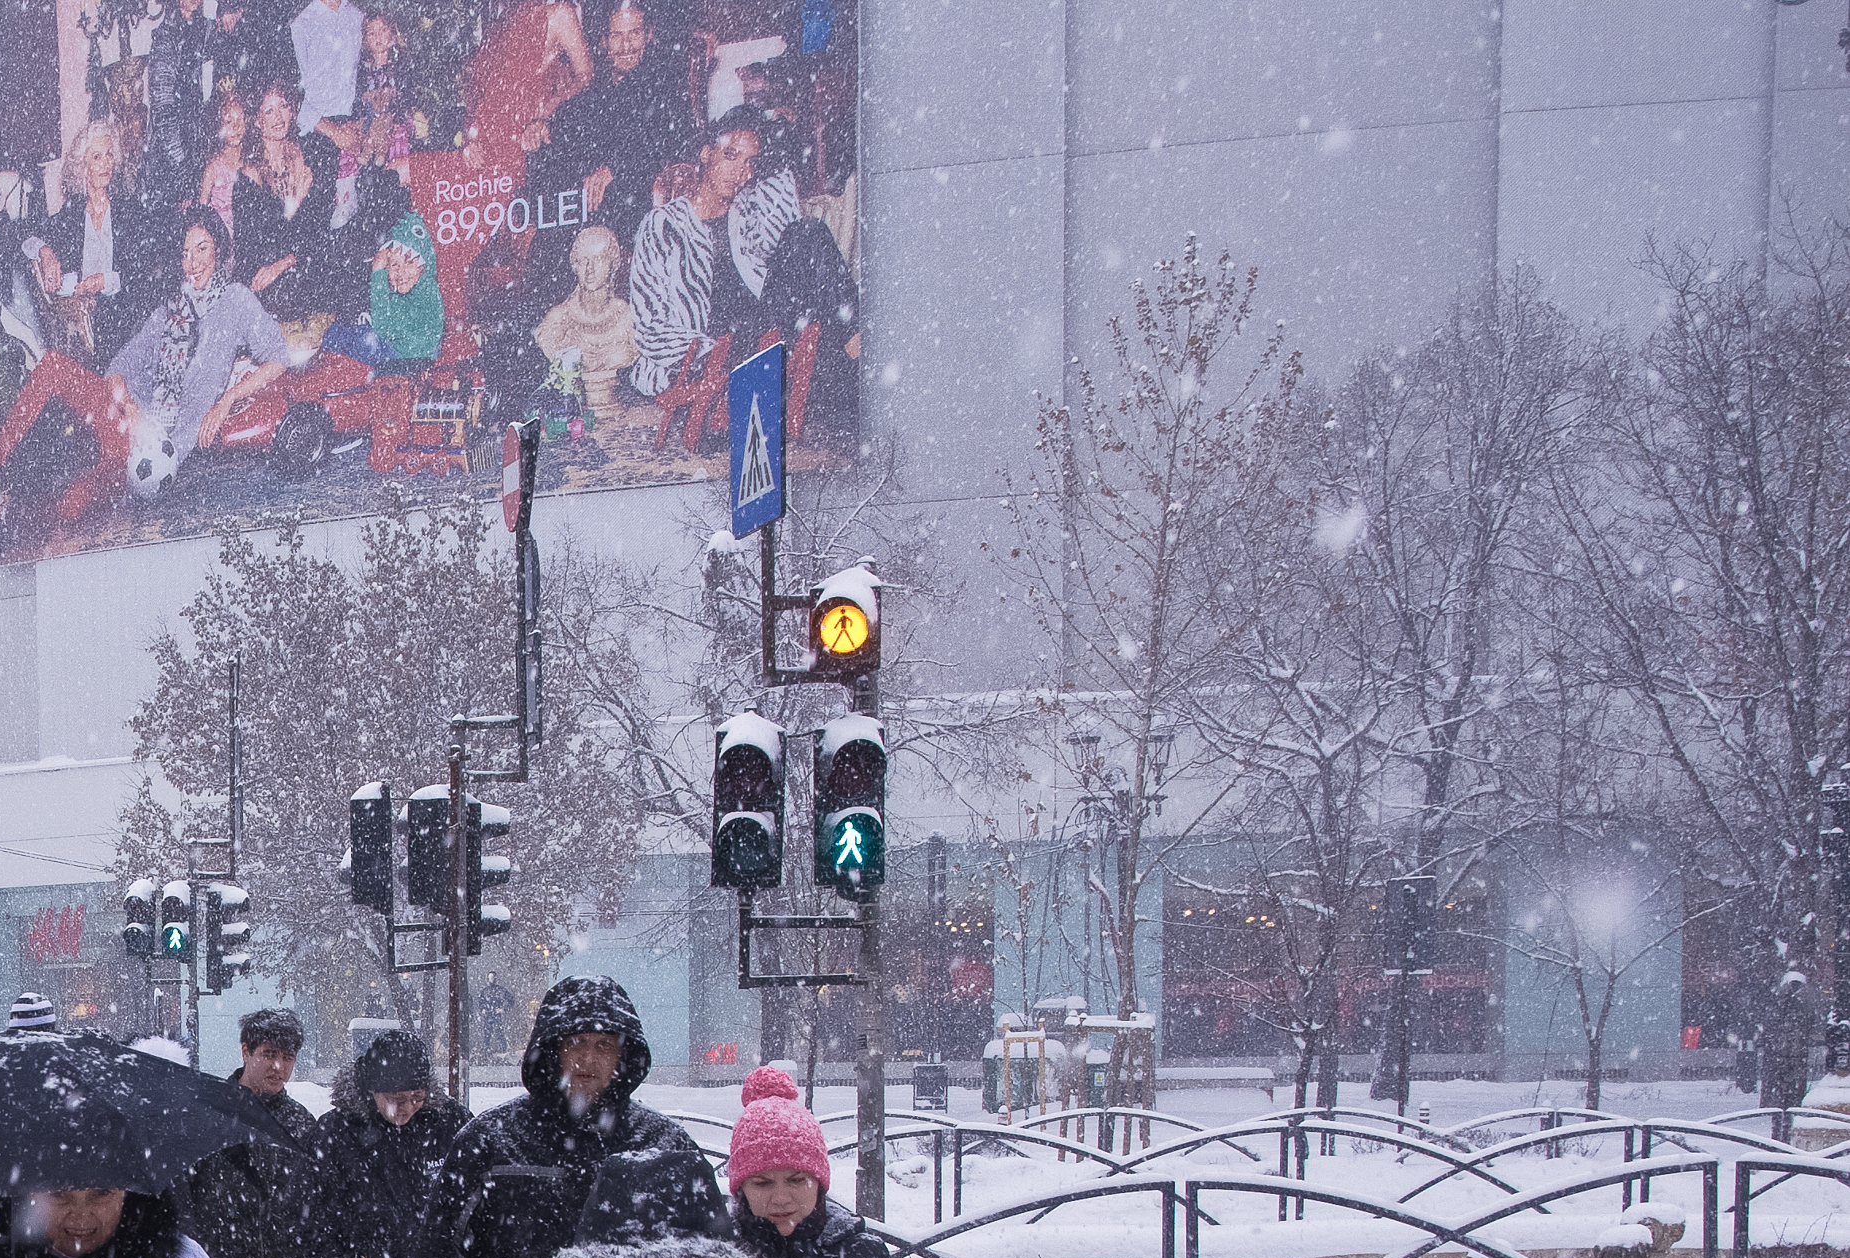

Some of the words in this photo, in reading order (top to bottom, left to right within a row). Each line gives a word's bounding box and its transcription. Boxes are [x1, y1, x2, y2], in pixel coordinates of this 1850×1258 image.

[434, 173, 513, 204] Rochie
[436, 198, 531, 245] 89,90
[537, 188, 588, 230] LEI
[654, 321, 821, 450] HM
